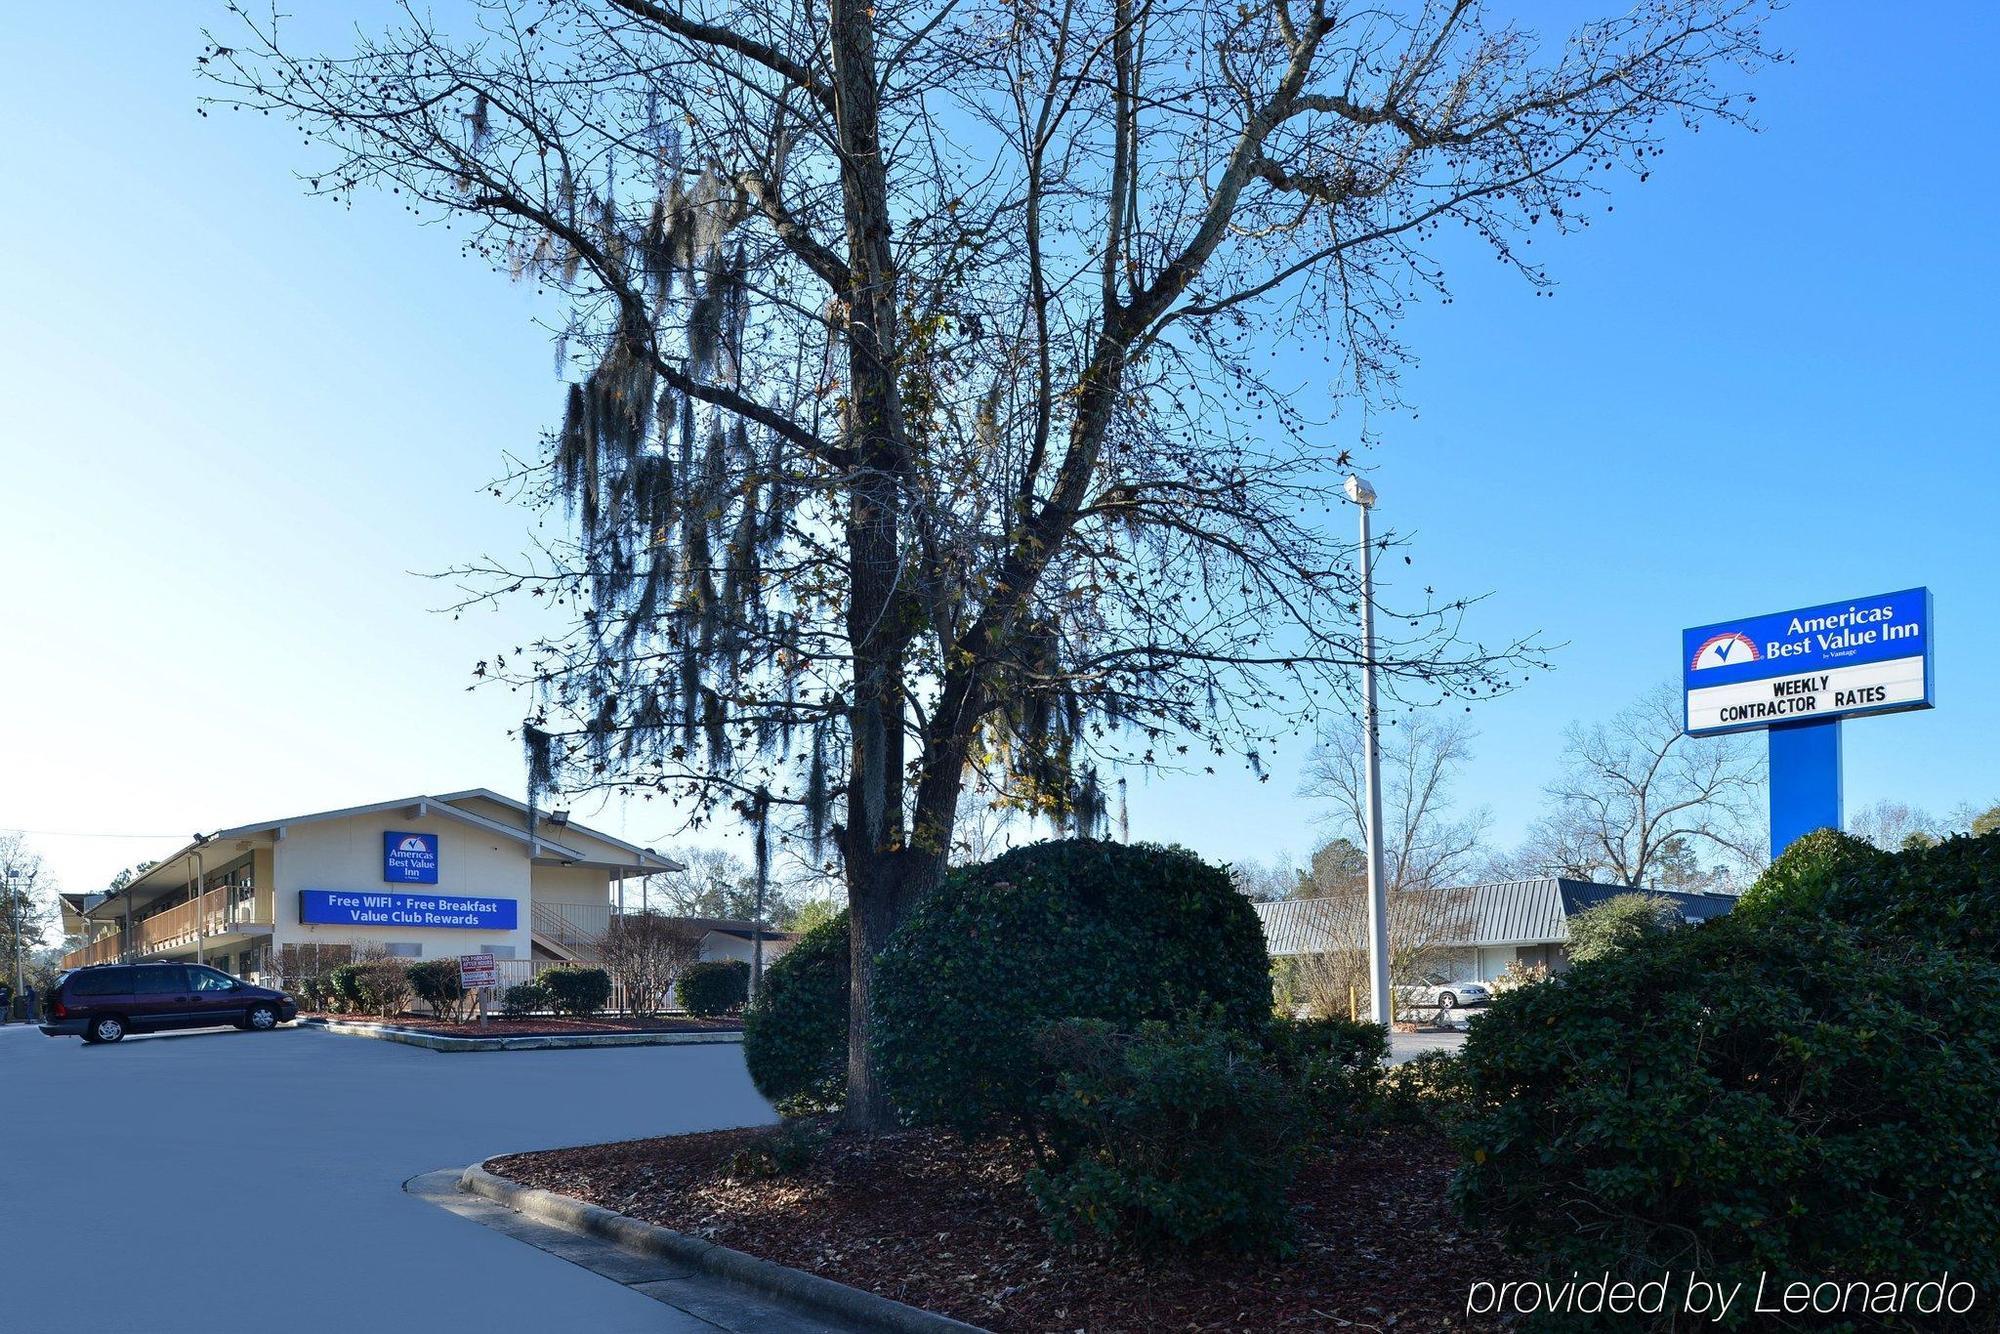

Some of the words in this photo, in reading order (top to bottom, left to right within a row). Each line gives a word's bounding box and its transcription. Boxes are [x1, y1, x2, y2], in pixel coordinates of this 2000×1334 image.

[1787, 606, 1894, 636] Americas
[1766, 637, 1812, 660] Best
[1817, 628, 1877, 651] Value
[1882, 622, 1919, 641] Inn
[1830, 649, 1857, 658] Vantage
[1773, 675, 1829, 697] WEEKLY
[1720, 696, 1816, 722] CONTRACTOR
[1835, 686, 1886, 707] RATES
[390, 849, 434, 859] Americas
[389, 857, 409, 867] Best
[410, 859, 435, 869] Value
[404, 867, 420, 877] Inn
[328, 894, 360, 907] Free
[363, 896, 392, 908] WIFI
[406, 898, 436, 910] Free
[438, 899, 497, 913] Breakfast
[350, 909, 389, 922] Value
[391, 911, 423, 923] Club
[425, 912, 479, 925] Rewards
